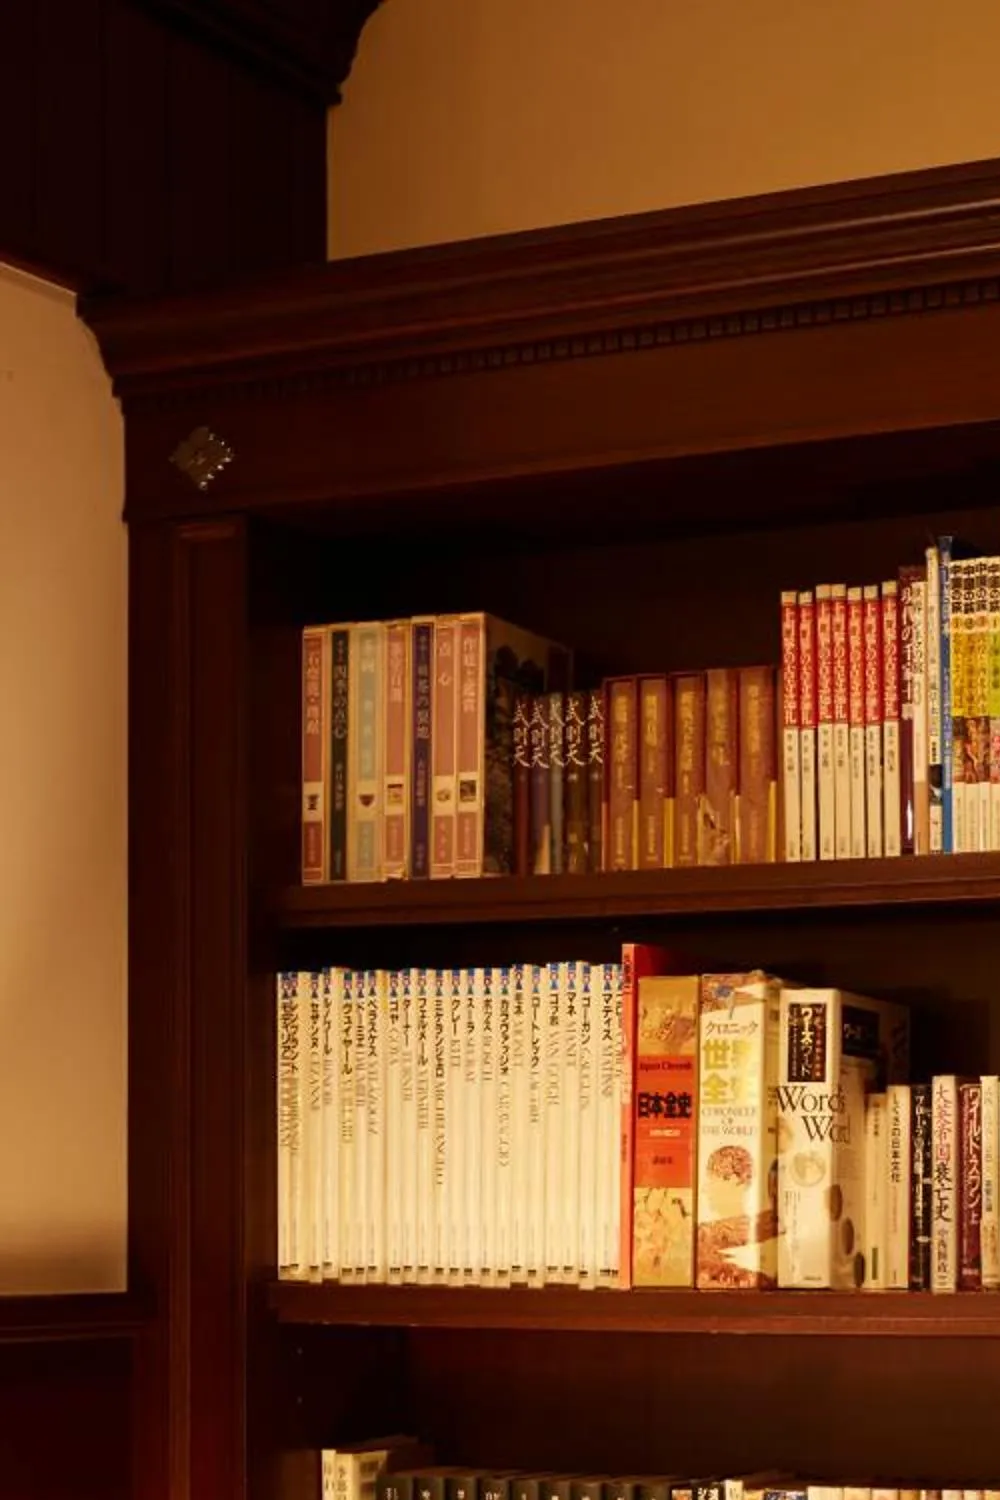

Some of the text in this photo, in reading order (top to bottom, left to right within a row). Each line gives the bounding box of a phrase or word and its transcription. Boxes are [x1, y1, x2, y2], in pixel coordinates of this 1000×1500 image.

[512, 700, 531, 768] 武則天
[531, 699, 549, 769] 武則天
[565, 696, 586, 768] 武則天
[602, 993, 614, 1042] マティス
[638, 1091, 692, 1120] 日本全史
